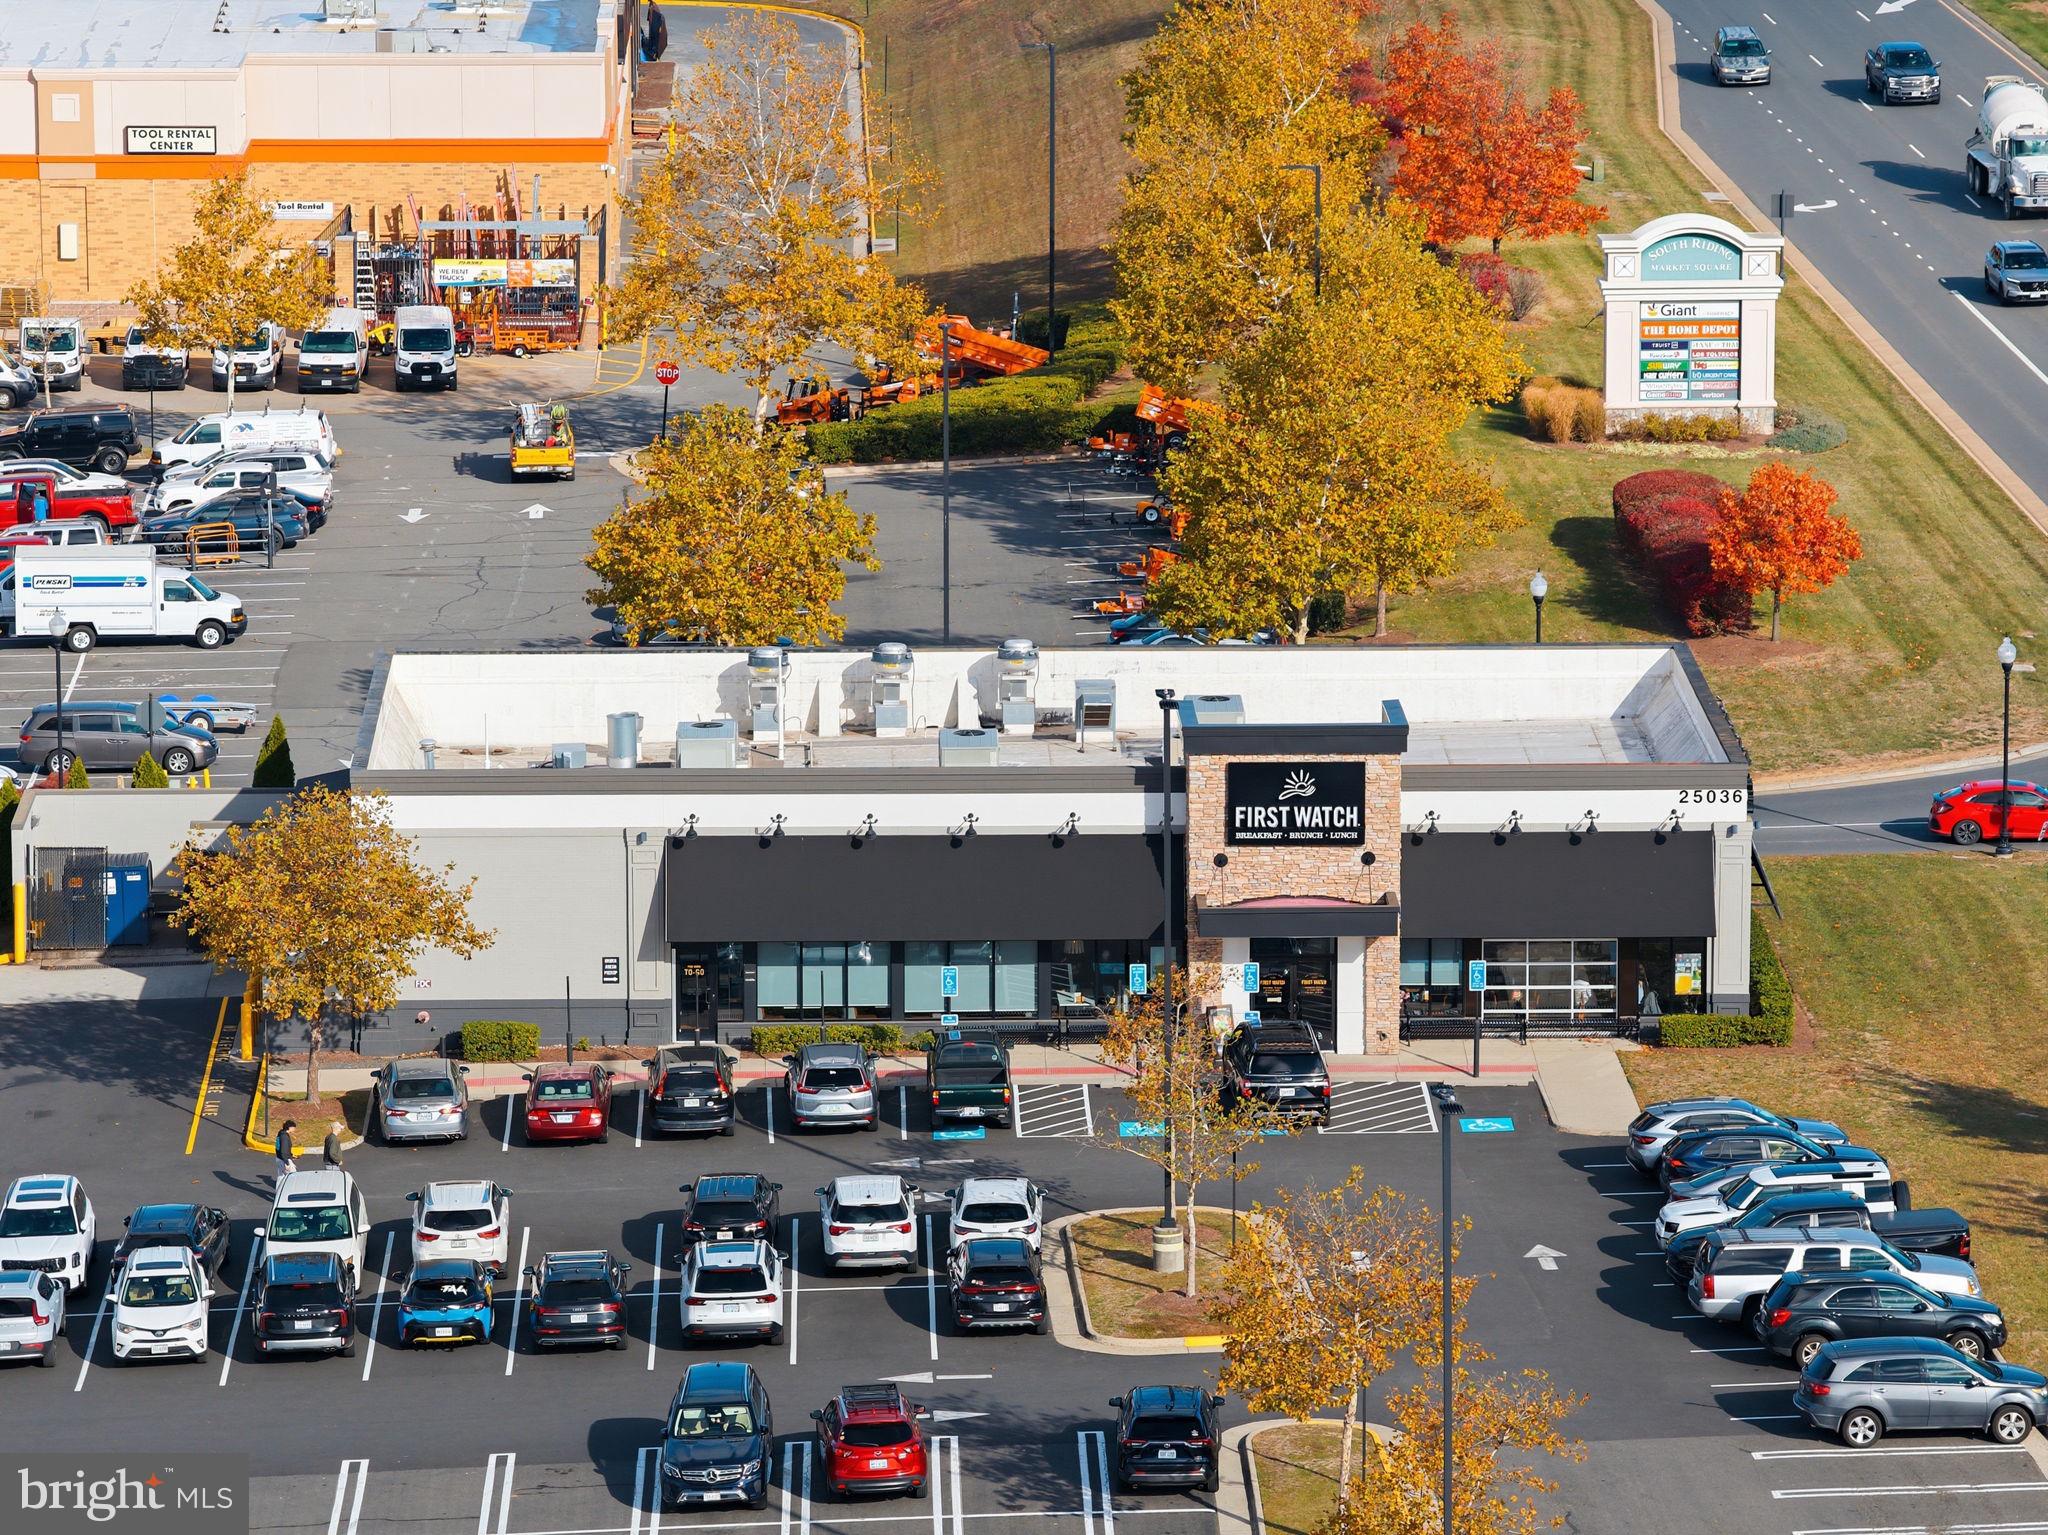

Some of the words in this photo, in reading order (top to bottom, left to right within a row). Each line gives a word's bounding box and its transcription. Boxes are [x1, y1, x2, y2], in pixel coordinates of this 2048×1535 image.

[132, 129, 164, 139] TOOL
[168, 129, 211, 139] RENTAL
[150, 141, 193, 150] CENTER
[1648, 239, 1688, 261] SOUTH
[1692, 238, 1734, 260] RIDING
[1694, 263, 1732, 271] SQUARE
[1661, 304, 1697, 316] Giant
[1643, 325, 1665, 335] THE
[1668, 325, 1699, 335] HOME
[1702, 324, 1737, 334] DEPOT
[657, 368, 679, 377] STOP
[1679, 789, 1742, 803] 25036
[1235, 806, 1290, 828] FIRST
[1235, 831, 1283, 839] BREAKFAST
[1289, 831, 1323, 839] BRUNCH
[1330, 831, 1358, 839] LUNCH
[684, 968, 705, 976] TO-GO
